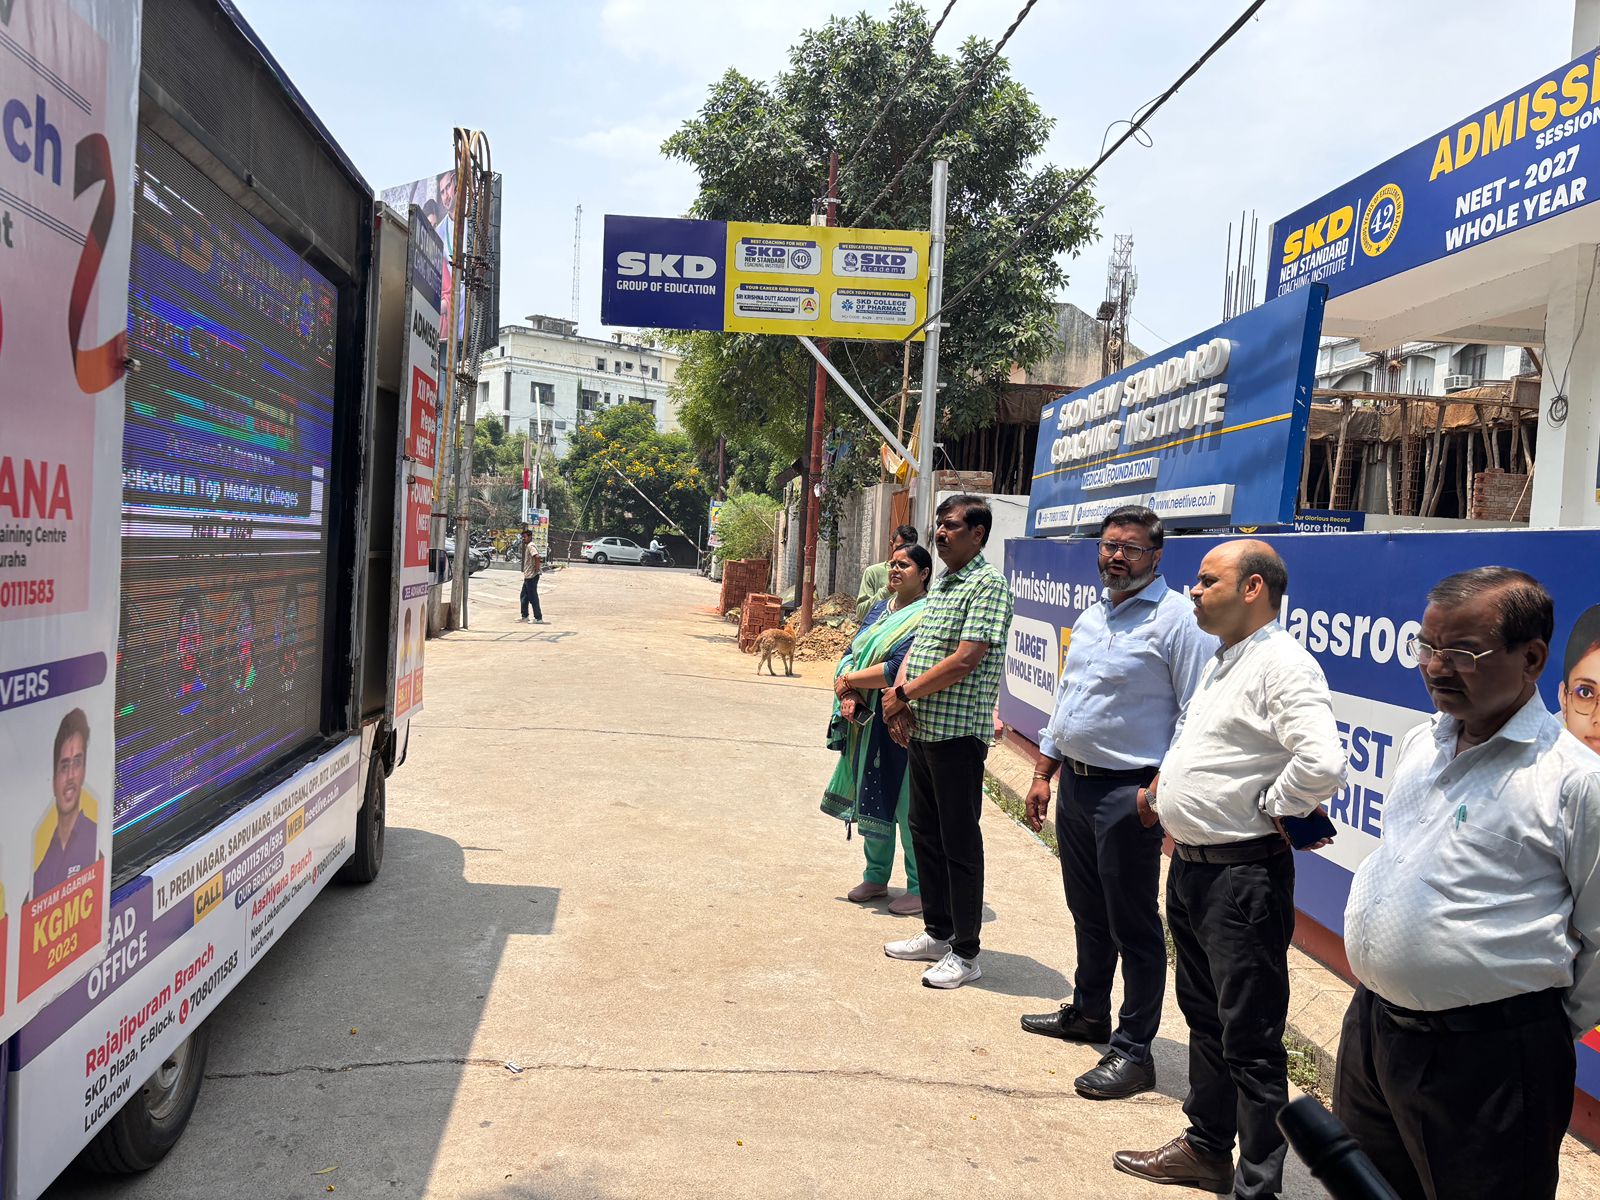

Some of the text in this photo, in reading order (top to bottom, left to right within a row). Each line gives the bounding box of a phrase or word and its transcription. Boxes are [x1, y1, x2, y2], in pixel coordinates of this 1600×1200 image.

[1455, 176, 1507, 219] NEET
[1524, 144, 1580, 190] 2027
[1370, 204, 1394, 235] 42
[1445, 176, 1587, 252] WHOLE YEAR
[745, 246, 786, 257] SKD
[1283, 205, 1354, 265] SKD
[617, 251, 717, 279] SKD
[860, 253, 907, 266] SKD
[862, 266, 905, 274] Academy
[1278, 256, 1347, 297] COACHING INSTITUTE
[1279, 237, 1349, 284] NEW STANDARD
[616, 280, 716, 295] GROUP OF EDUCATION
[1057, 338, 1231, 430] SKD NEW STANDARD
[1051, 383, 1229, 465] COACHING INSTITUTE
[223, 480, 263, 503] Medical
[1081, 460, 1152, 487] MEDICAL FOUNDATION
[1155, 492, 1216, 510] www.neetlive.co.in
[35, 525, 66, 543] Centre
[1295, 522, 1348, 532] More than
[1010, 570, 1071, 607] Admissions
[1074, 584, 1097, 610] are
[1015, 630, 1047, 662] TARGET
[1007, 655, 1032, 683] (WHOLE
[1033, 666, 1055, 696] YEAR)
[157, 885, 168, 910] 11,
[170, 868, 195, 900] PREM
[196, 844, 227, 880] NAGAR,
[228, 825, 251, 857] SAPRU
[196, 882, 222, 914] CALL
[287, 814, 303, 838] WEB
[238, 856, 283, 903] OUR BRANCHES
[251, 848, 314, 920] Aashiyana Branch
[31, 868, 96, 917] SHYAM AGARWAL
[33, 887, 94, 954] KGMC
[250, 921, 264, 941] Near
[47, 932, 78, 970] 2023
[250, 926, 275, 959] Lucknow
[87, 930, 148, 1000] OFFICE
[86, 942, 215, 1078] Rajajipuram Branch
[85, 1073, 107, 1108] SKD
[109, 1049, 138, 1083] Plaza,
[140, 1009, 176, 1052] E-Block,
[84, 1075, 132, 1133] Lucknow
